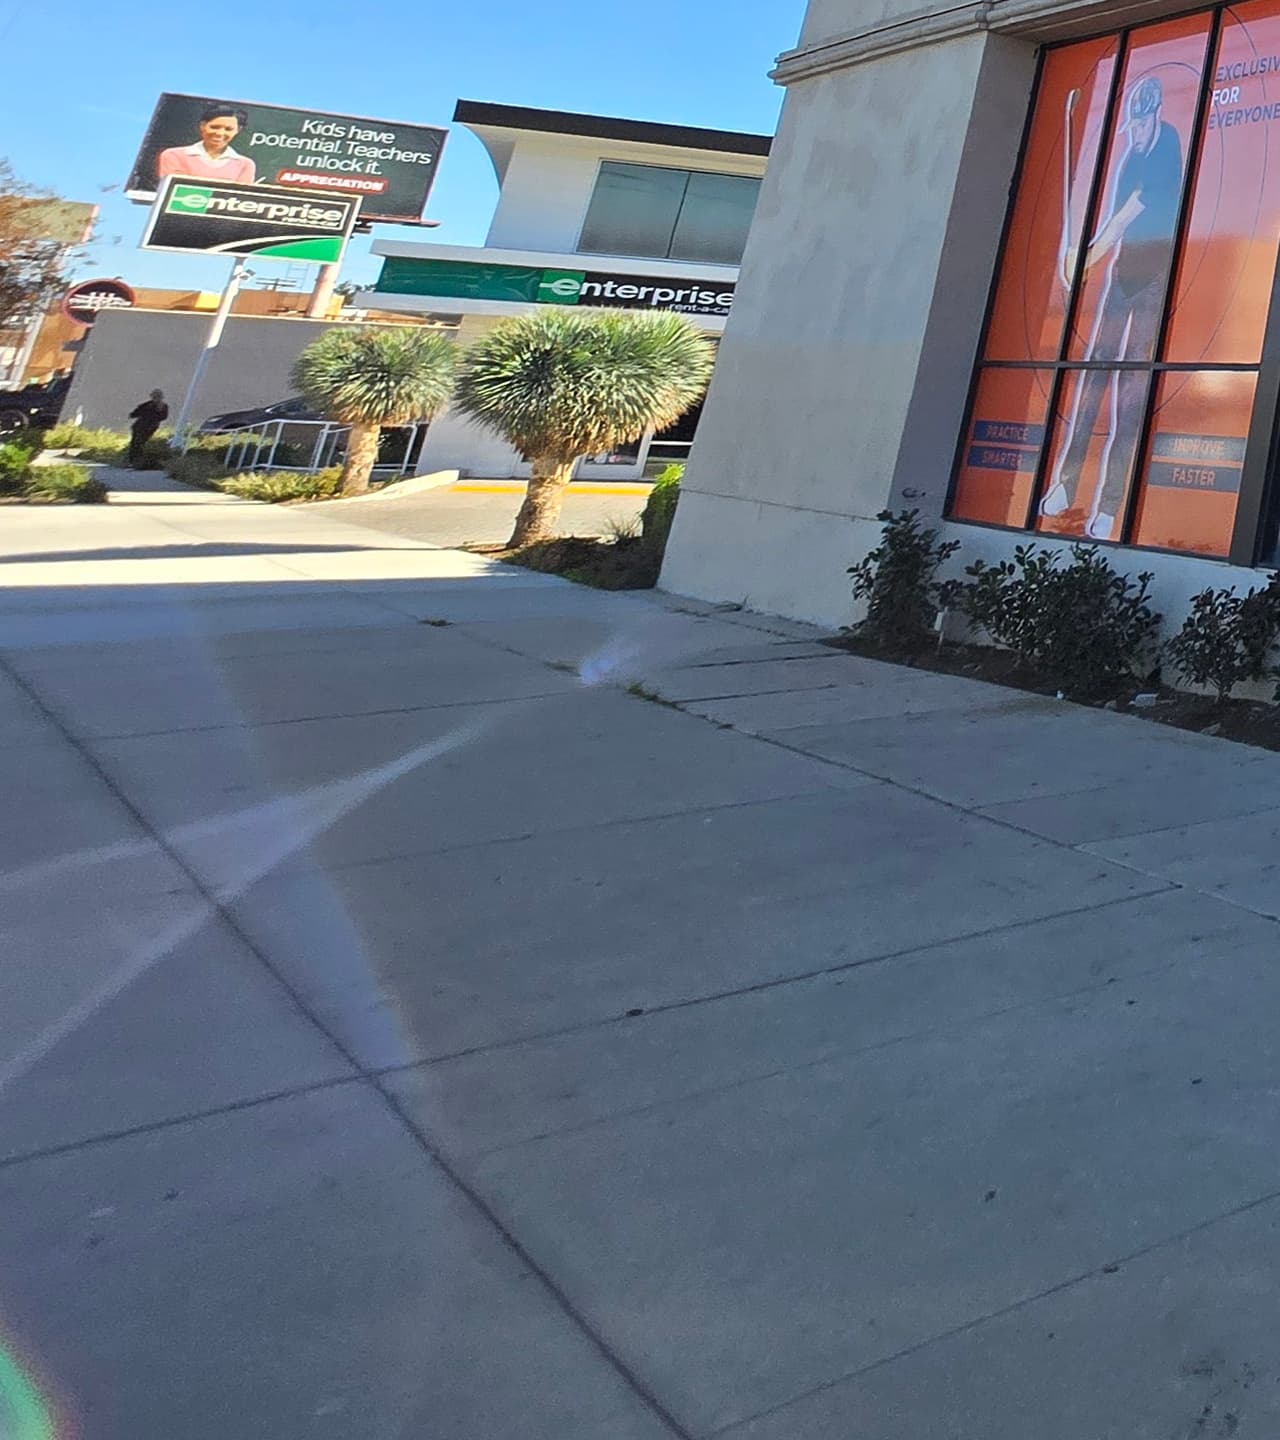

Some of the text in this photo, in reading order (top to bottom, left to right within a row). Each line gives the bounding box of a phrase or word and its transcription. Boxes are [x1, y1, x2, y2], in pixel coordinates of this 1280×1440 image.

[1211, 86, 1240, 106] FOR
[302, 119, 396, 145] Kids have
[249, 131, 432, 165] potential. Teachers
[296, 154, 383, 175] unlock it.
[279, 171, 385, 192] APPRECIATION
[174, 193, 343, 222] enterprise
[539, 277, 735, 307] enterprise
[668, 302, 729, 314] rent-a-ca
[986, 425, 1030, 442] PRACTICE
[1173, 438, 1225, 457] IMPROVE
[1171, 467, 1216, 486] FASTER
